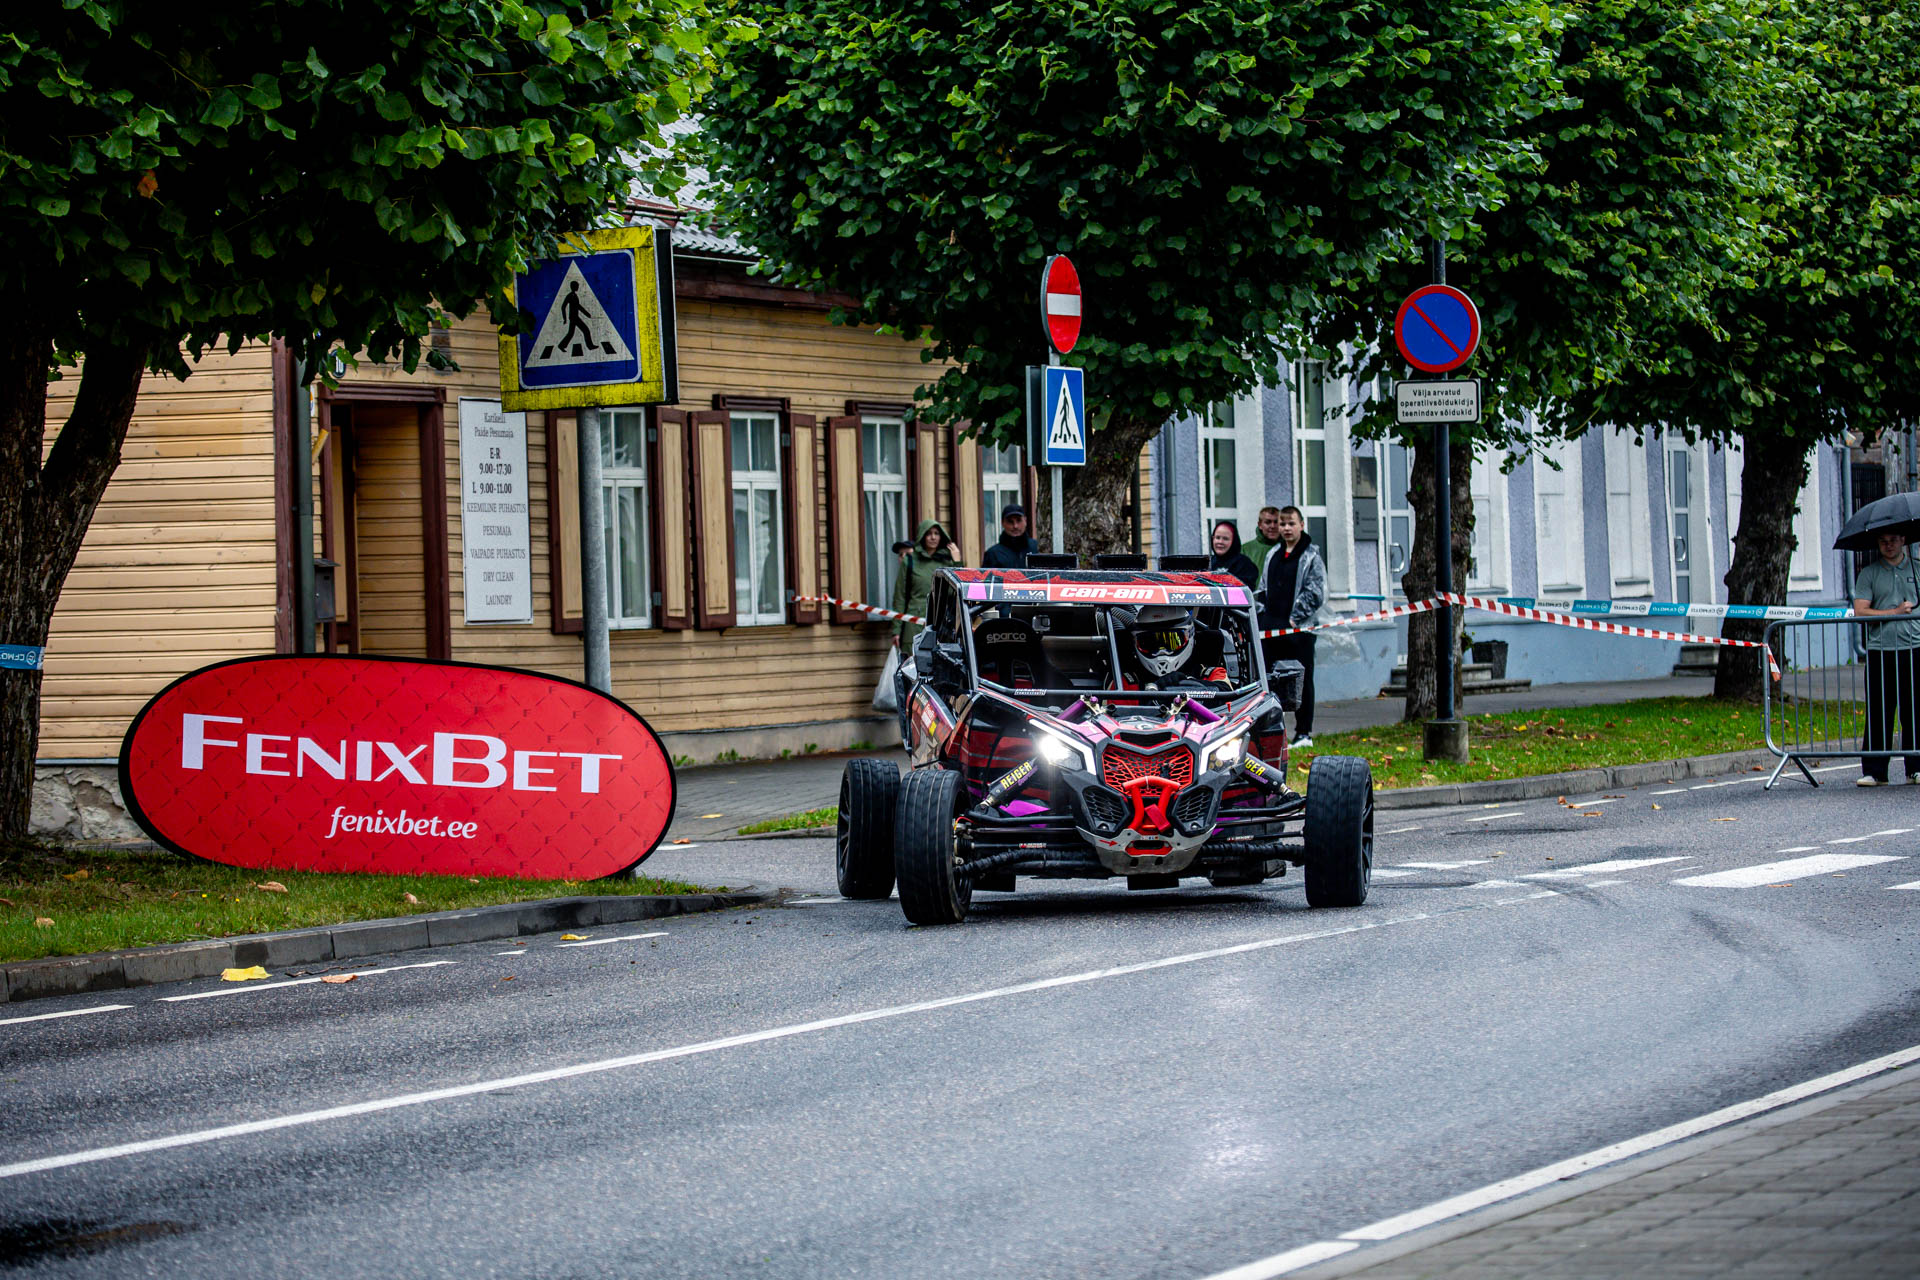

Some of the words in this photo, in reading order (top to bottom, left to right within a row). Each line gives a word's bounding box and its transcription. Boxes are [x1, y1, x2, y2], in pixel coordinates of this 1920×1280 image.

[1412, 389, 1431, 398] Välja
[1433, 388, 1461, 396] arvatud
[490, 448, 501, 459] E-R
[472, 482, 477, 494] L
[466, 503, 497, 513] KEEMILINE
[498, 503, 526, 513] PUHASTUS
[483, 526, 512, 536] PESUMAJA
[470, 549, 495, 559] VAIPADE
[497, 549, 526, 559] PUHASTUS
[483, 571, 495, 582] DRY
[496, 572, 514, 582] CLEAN
[1060, 588, 1154, 599] can-am
[485, 595, 512, 605] LAUNDRY
[0, 653, 25, 661] CFMO
[1000, 761, 1032, 790] REIGER
[325, 806, 478, 839] fenixbet.ee
